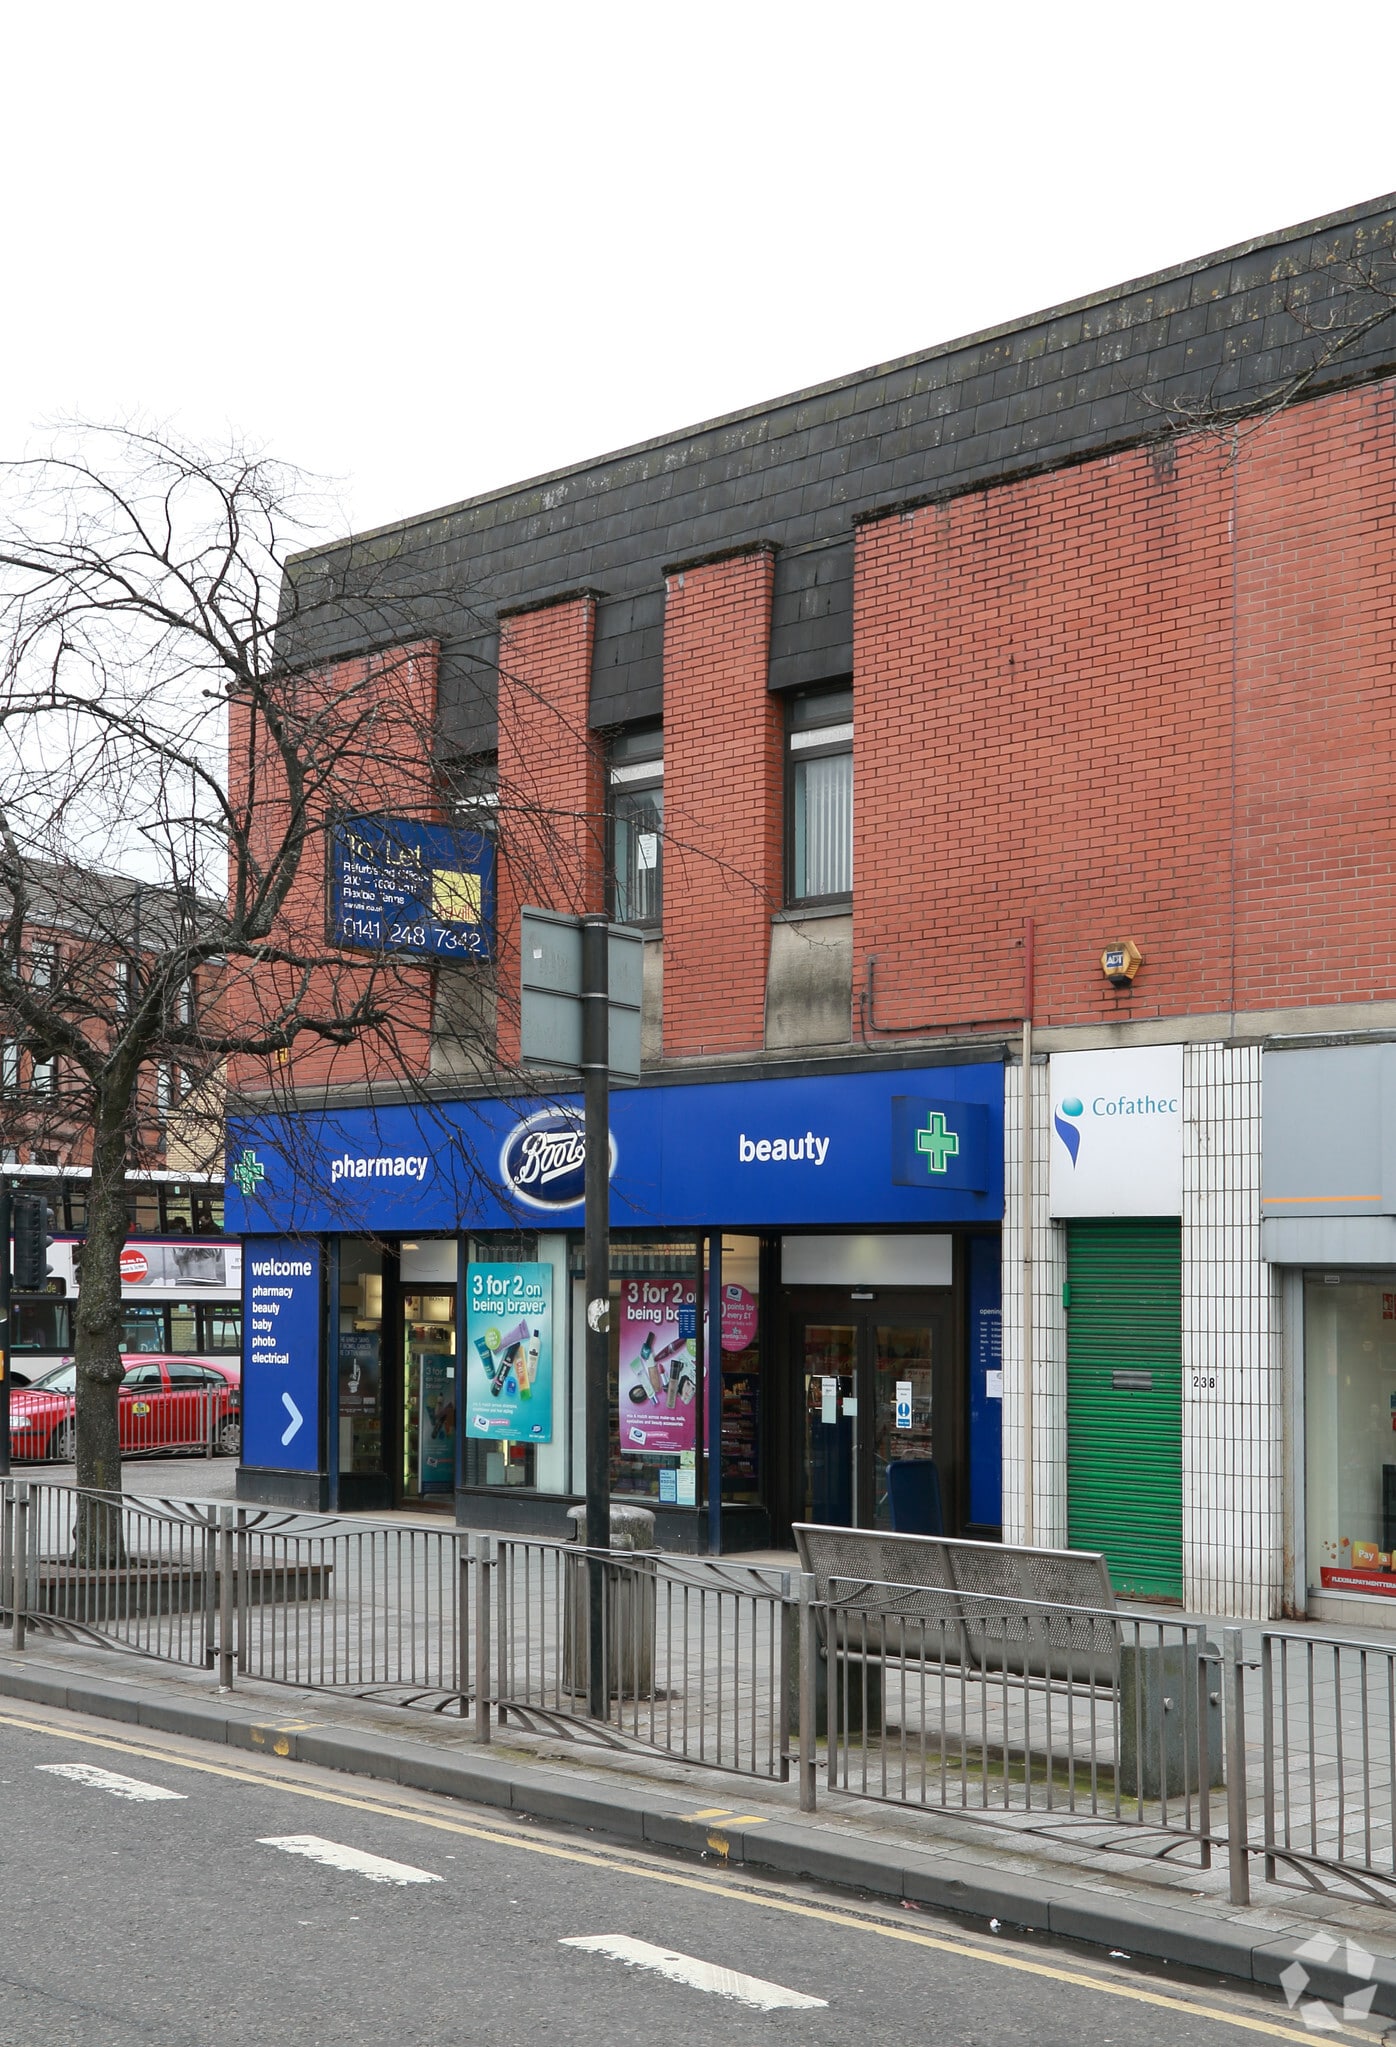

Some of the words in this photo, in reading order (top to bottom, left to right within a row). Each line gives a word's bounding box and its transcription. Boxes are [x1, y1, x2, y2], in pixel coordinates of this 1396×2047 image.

[344, 832, 374, 862] To
[386, 840, 421, 868] Let
[343, 861, 396, 877] Refurbised
[379, 892, 405, 905] erms
[343, 918, 380, 939] 0141
[390, 923, 426, 945] 248
[434, 928, 481, 952] 7342
[1107, 955, 1123, 965] ADT
[1092, 1096, 1178, 1116] Cofathec
[740, 1131, 830, 1165] beauty
[514, 1130, 586, 1185] Boots
[331, 1154, 428, 1183] pharmacy
[252, 1258, 312, 1276] welcome
[252, 1285, 293, 1299] pharmacy
[473, 1275, 483, 1295] 3
[486, 1275, 510, 1295] for
[513, 1275, 523, 1296] 2
[526, 1284, 541, 1296] on
[627, 1282, 638, 1303] 3
[642, 1282, 669, 1303] for
[672, 1282, 683, 1303] 2
[686, 1292, 697, 1303] o
[252, 1302, 280, 1316] beauty
[473, 1298, 504, 1314] being
[507, 1298, 545, 1313] braver
[627, 1305, 661, 1323] being
[252, 1318, 272, 1332] baby
[252, 1335, 276, 1348] photo
[252, 1352, 289, 1364] electrical
[1193, 1376, 1215, 1388] 238
[1358, 1549, 1375, 1561] Pay
